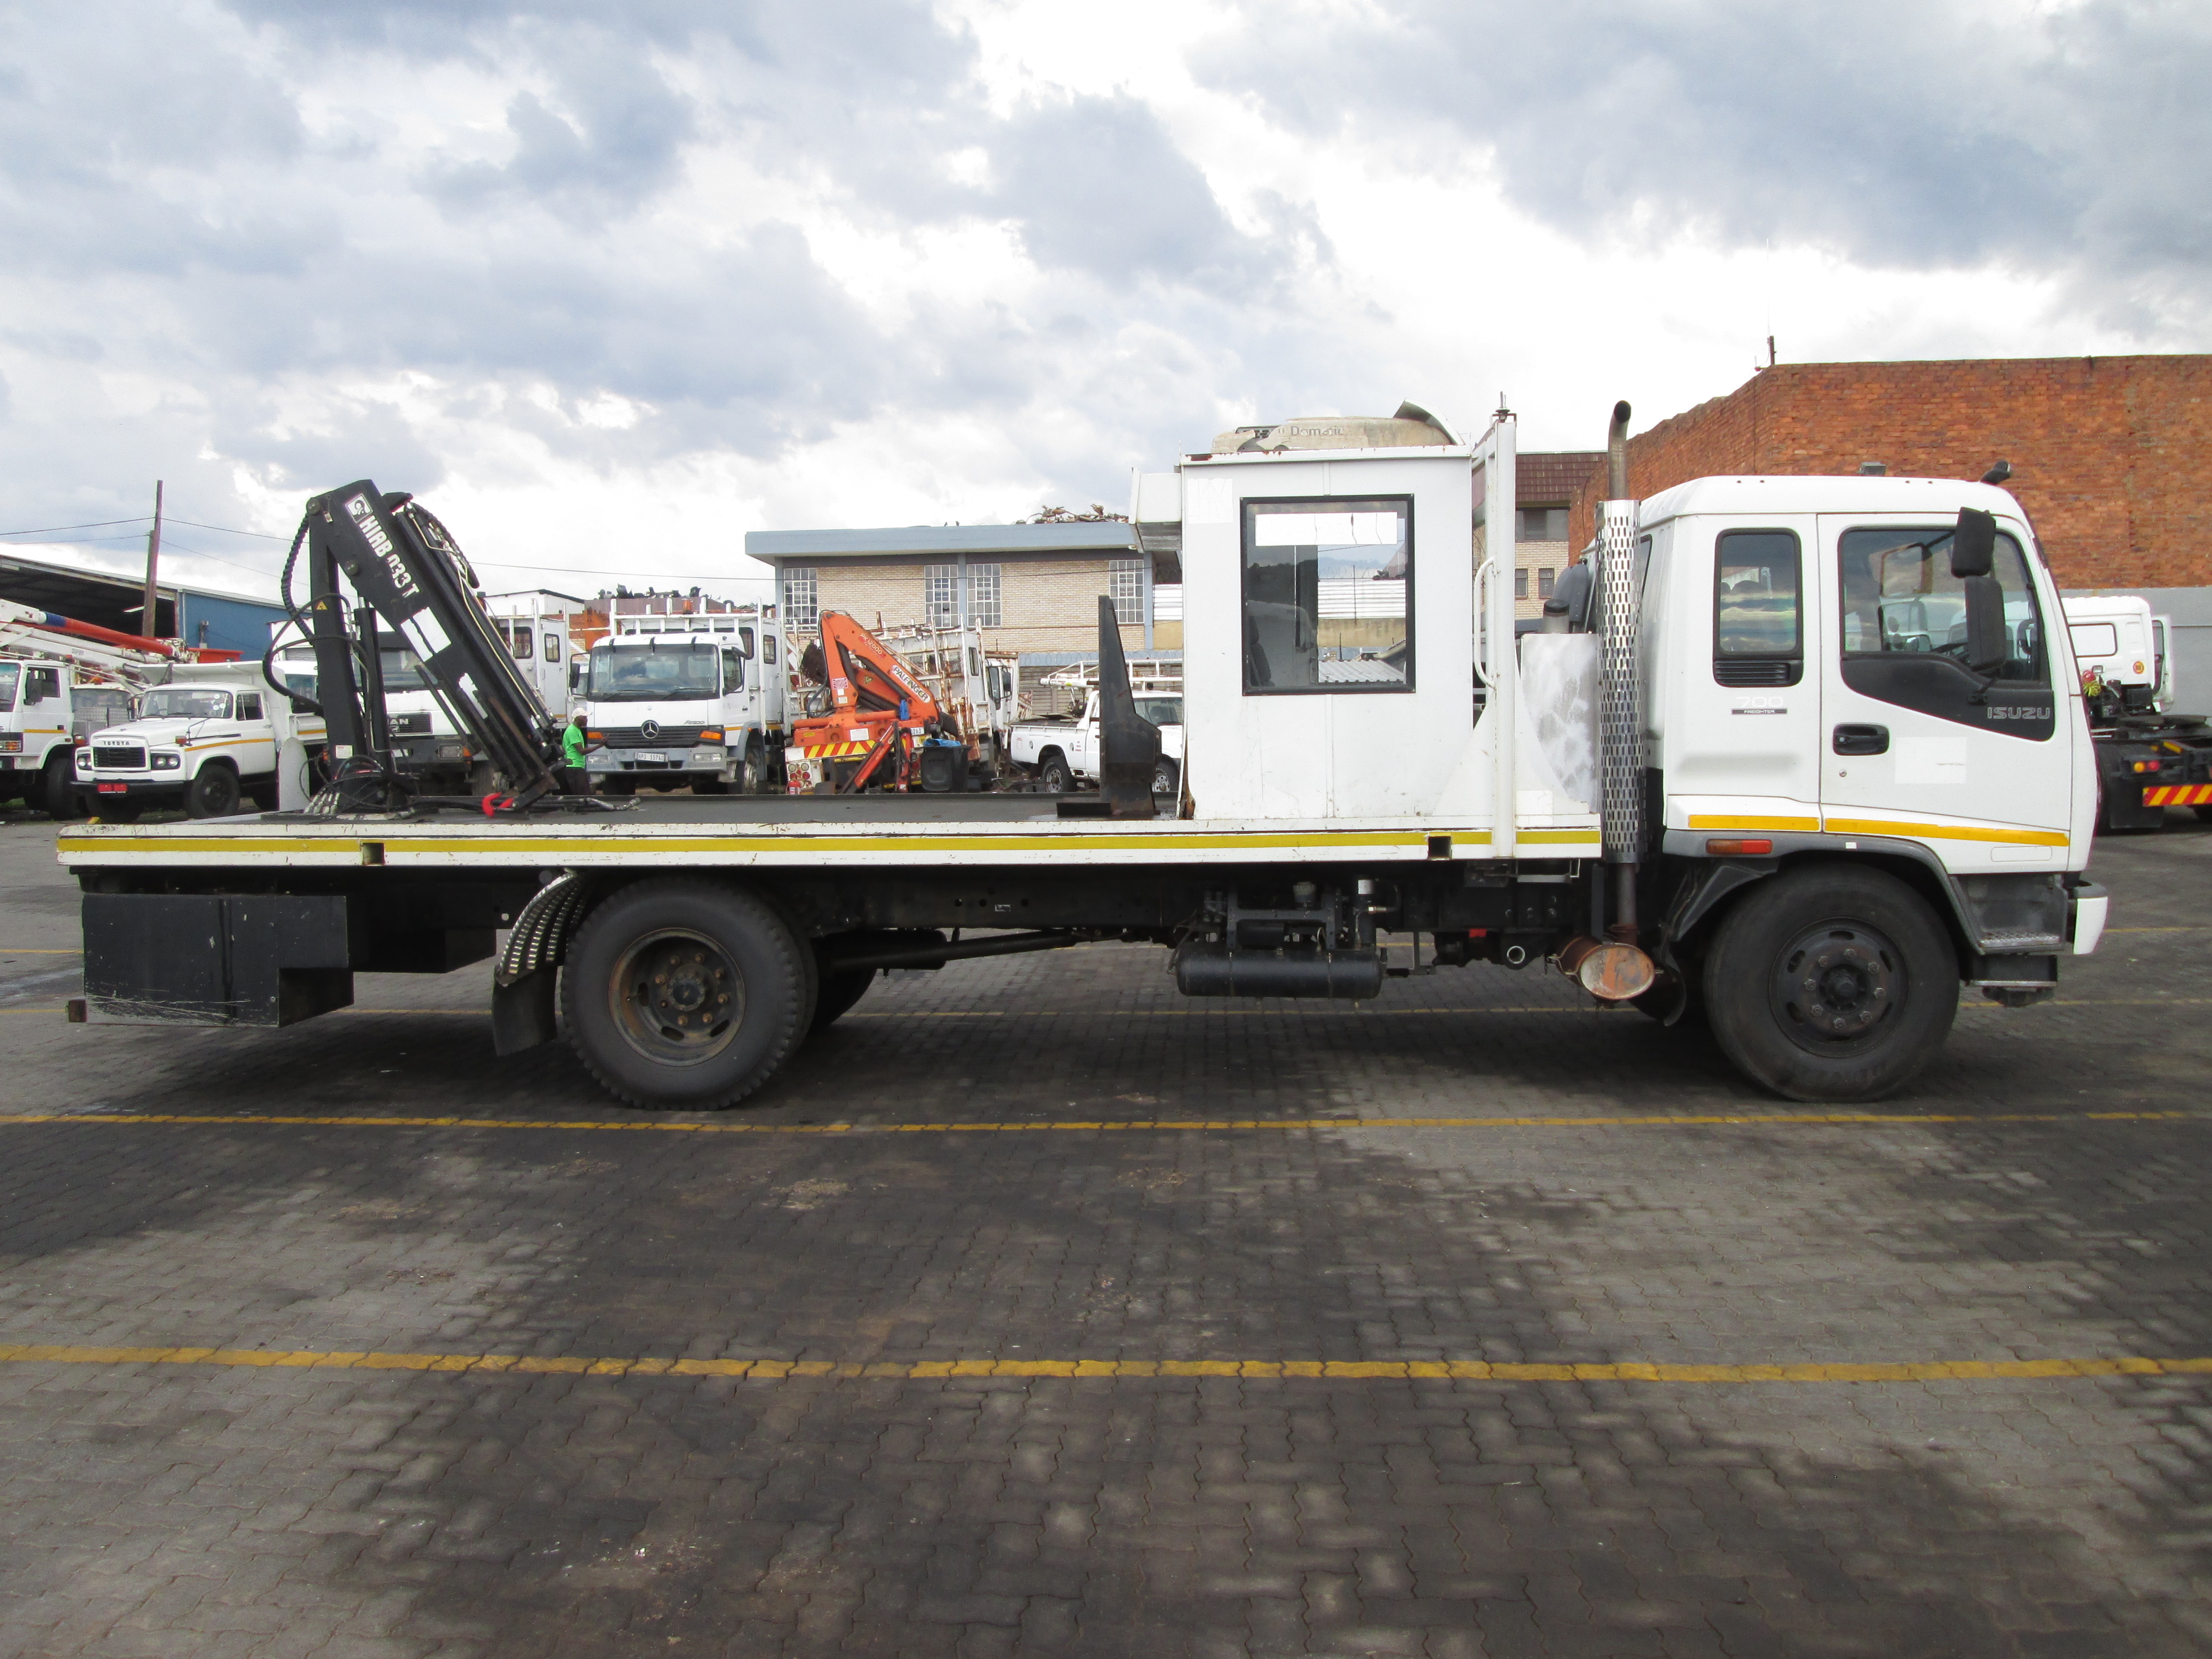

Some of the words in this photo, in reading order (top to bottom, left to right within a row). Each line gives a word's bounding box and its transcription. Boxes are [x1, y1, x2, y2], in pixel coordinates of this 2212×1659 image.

[359, 515, 393, 557] HIAB
[402, 583, 421, 598] T
[893, 666, 928, 701] PALFINGER
[1735, 696, 1783, 708] 700
[1987, 707, 2051, 719] ISUZU
